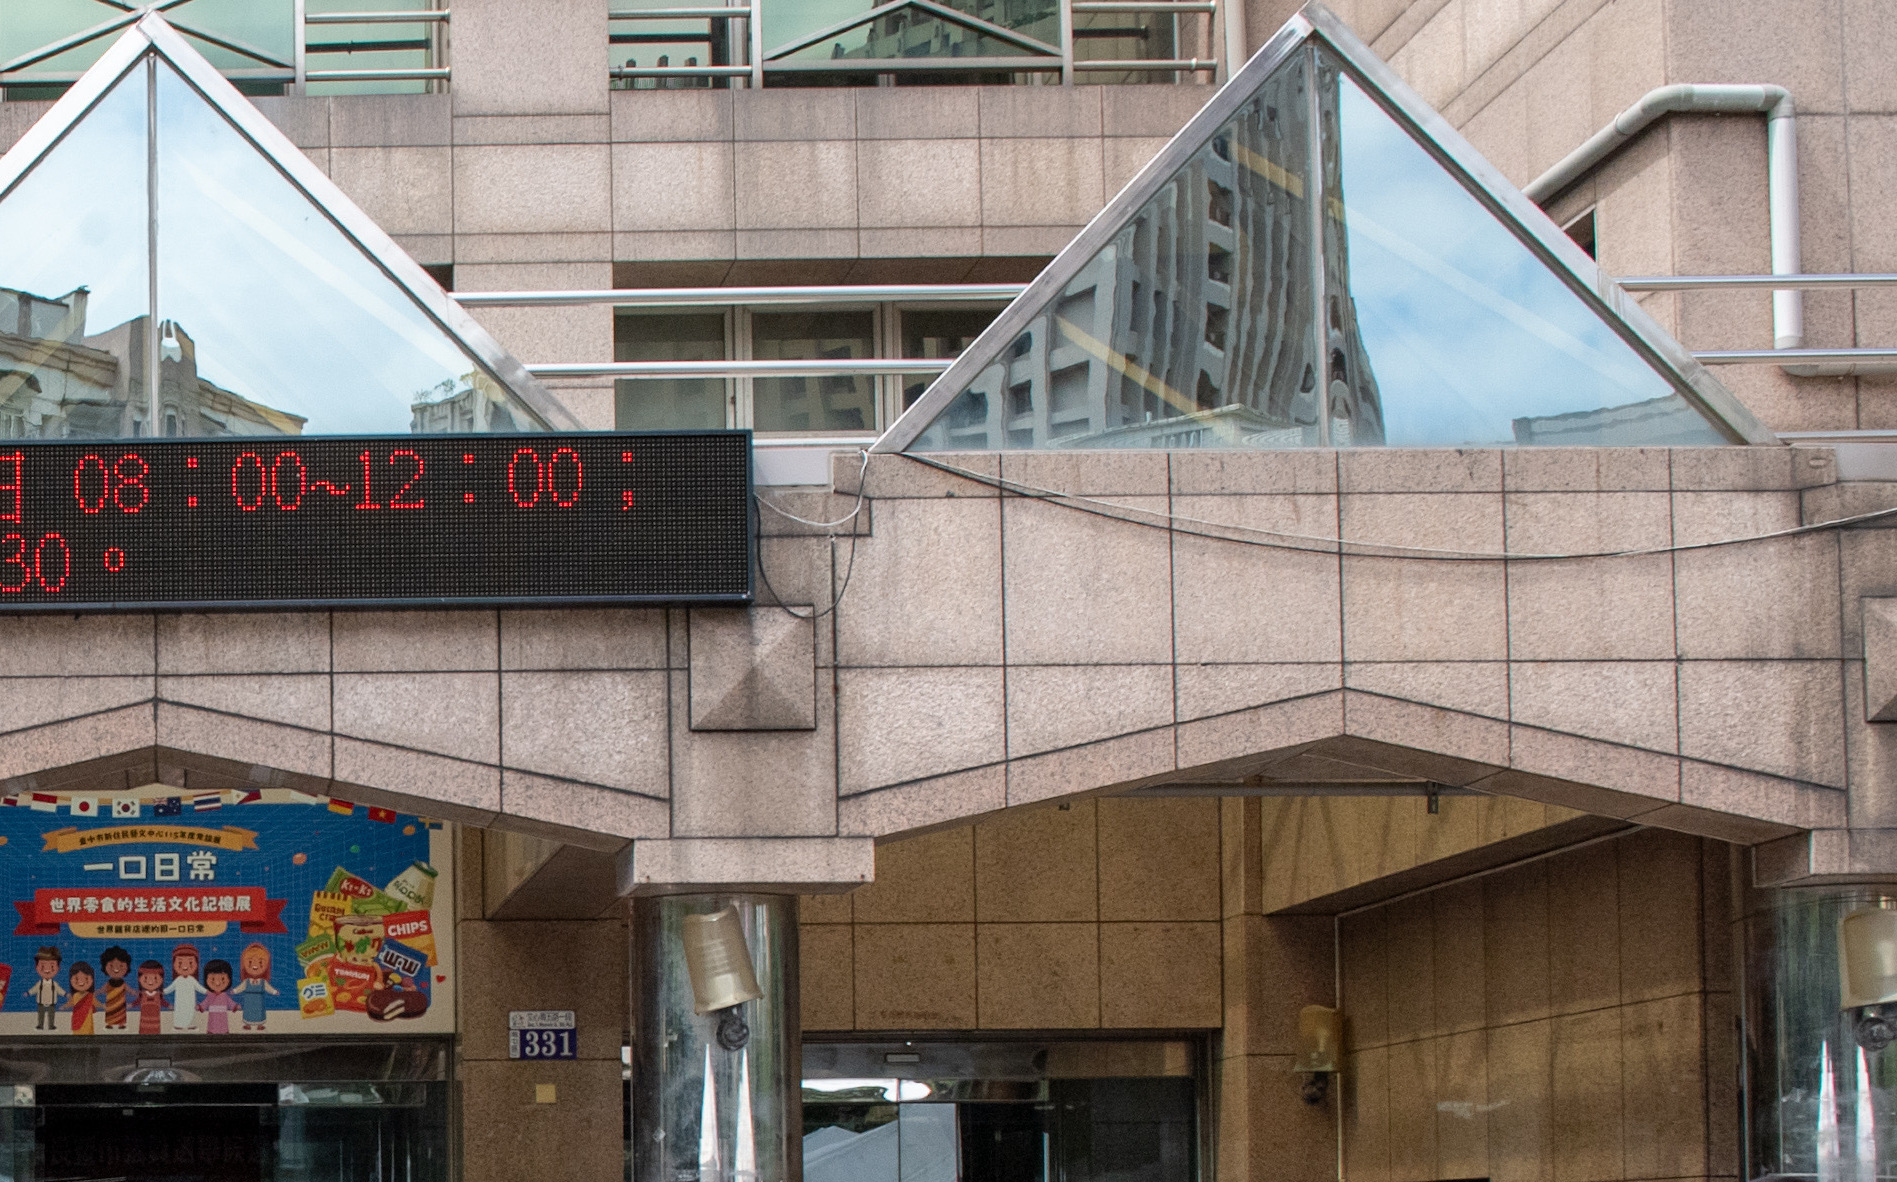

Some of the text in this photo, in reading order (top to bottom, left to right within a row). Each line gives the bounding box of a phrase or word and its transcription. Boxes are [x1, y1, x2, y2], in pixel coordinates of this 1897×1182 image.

[83, 851, 218, 882] 一口日常
[50, 895, 252, 914] 世界零食的生活文化記憶展
[387, 920, 429, 937] CHIPS
[525, 1030, 573, 1056] 331
